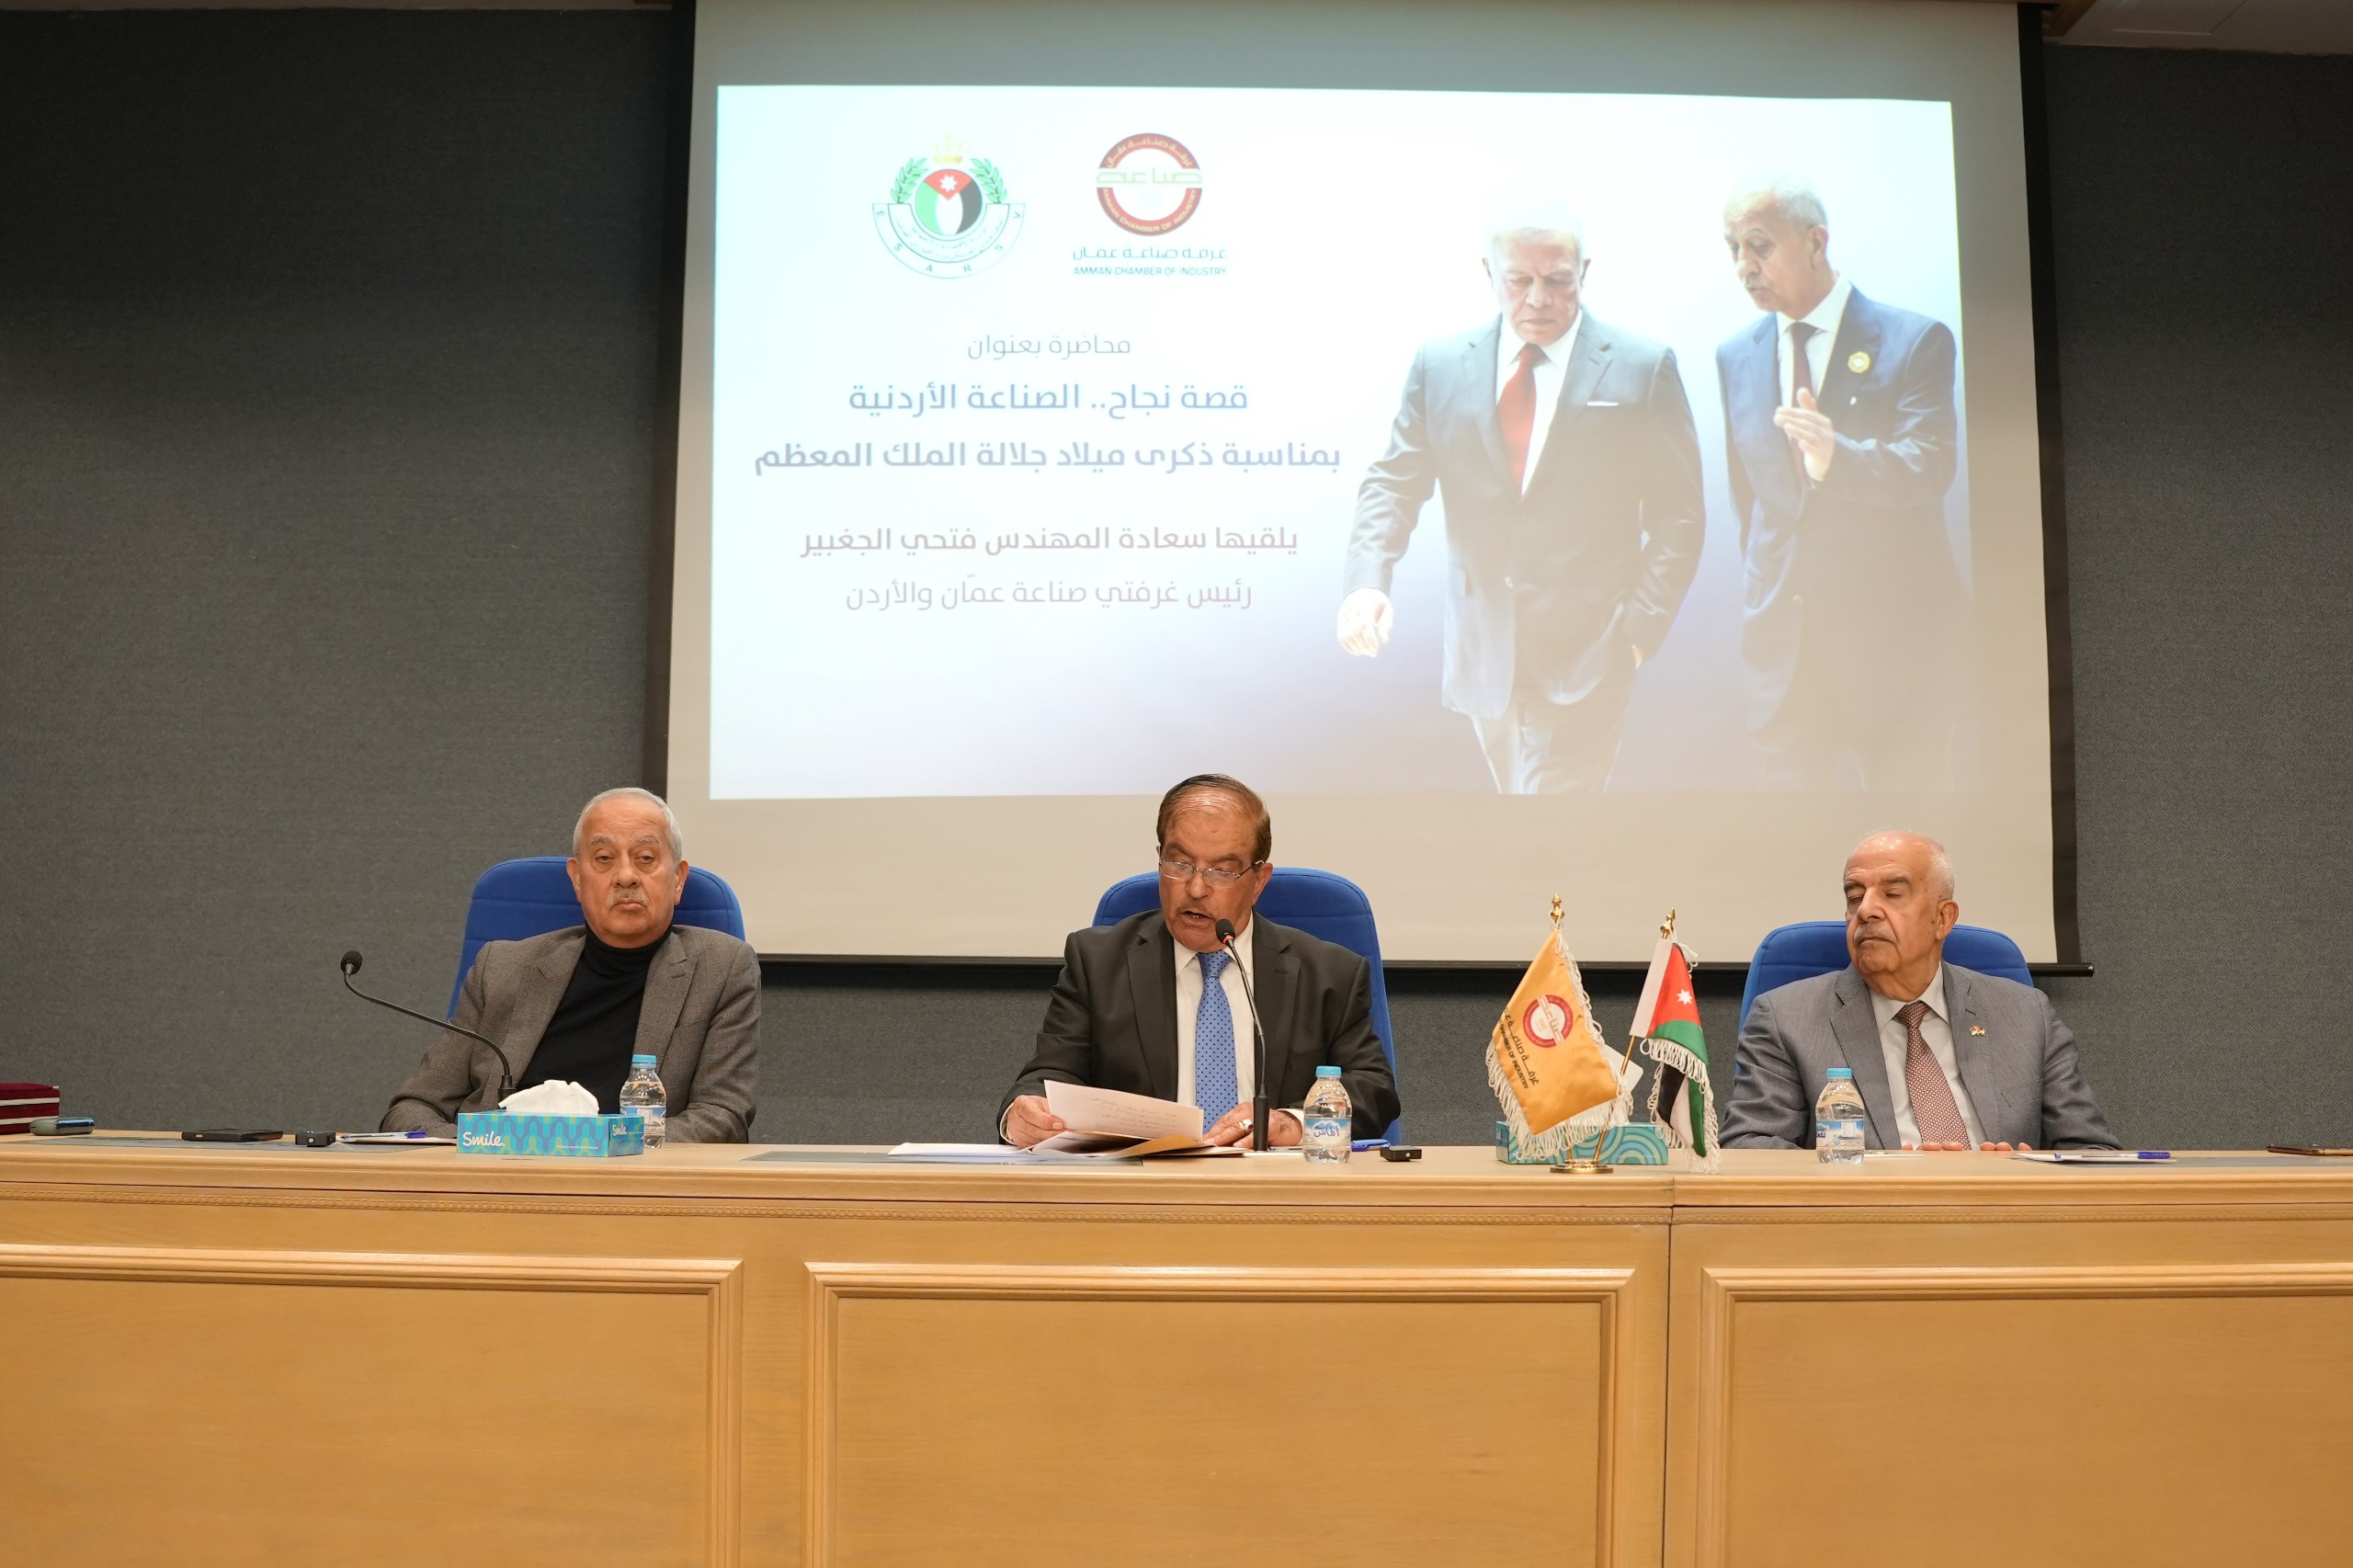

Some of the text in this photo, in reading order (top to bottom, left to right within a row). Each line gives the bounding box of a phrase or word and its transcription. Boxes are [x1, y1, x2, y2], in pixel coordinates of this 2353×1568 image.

[1102, 188, 1198, 233] AMMAN CHAMBER OF INDUSTRY
[1073, 267, 1228, 276] AMMAN CHAMBER OF INDUSTRY
[967, 334, 1131, 361] محاضرة بعنوان
[847, 381, 1248, 420] قصة نجاح.. الصناعة الأردنية
[754, 441, 1342, 477] بمناسبة ذكرى ميلاد جلالة الملك المعظم
[799, 526, 1299, 559] يلقيها سعادة المهندس فتحي الجغبير
[845, 579, 933, 611] والأردن
[1011, 580, 1087, 604] صناعة
[1094, 580, 1179, 610] غرفتي
[1186, 577, 1253, 610] رئيس
[1512, 1060, 1529, 1089] INDUSTRY
